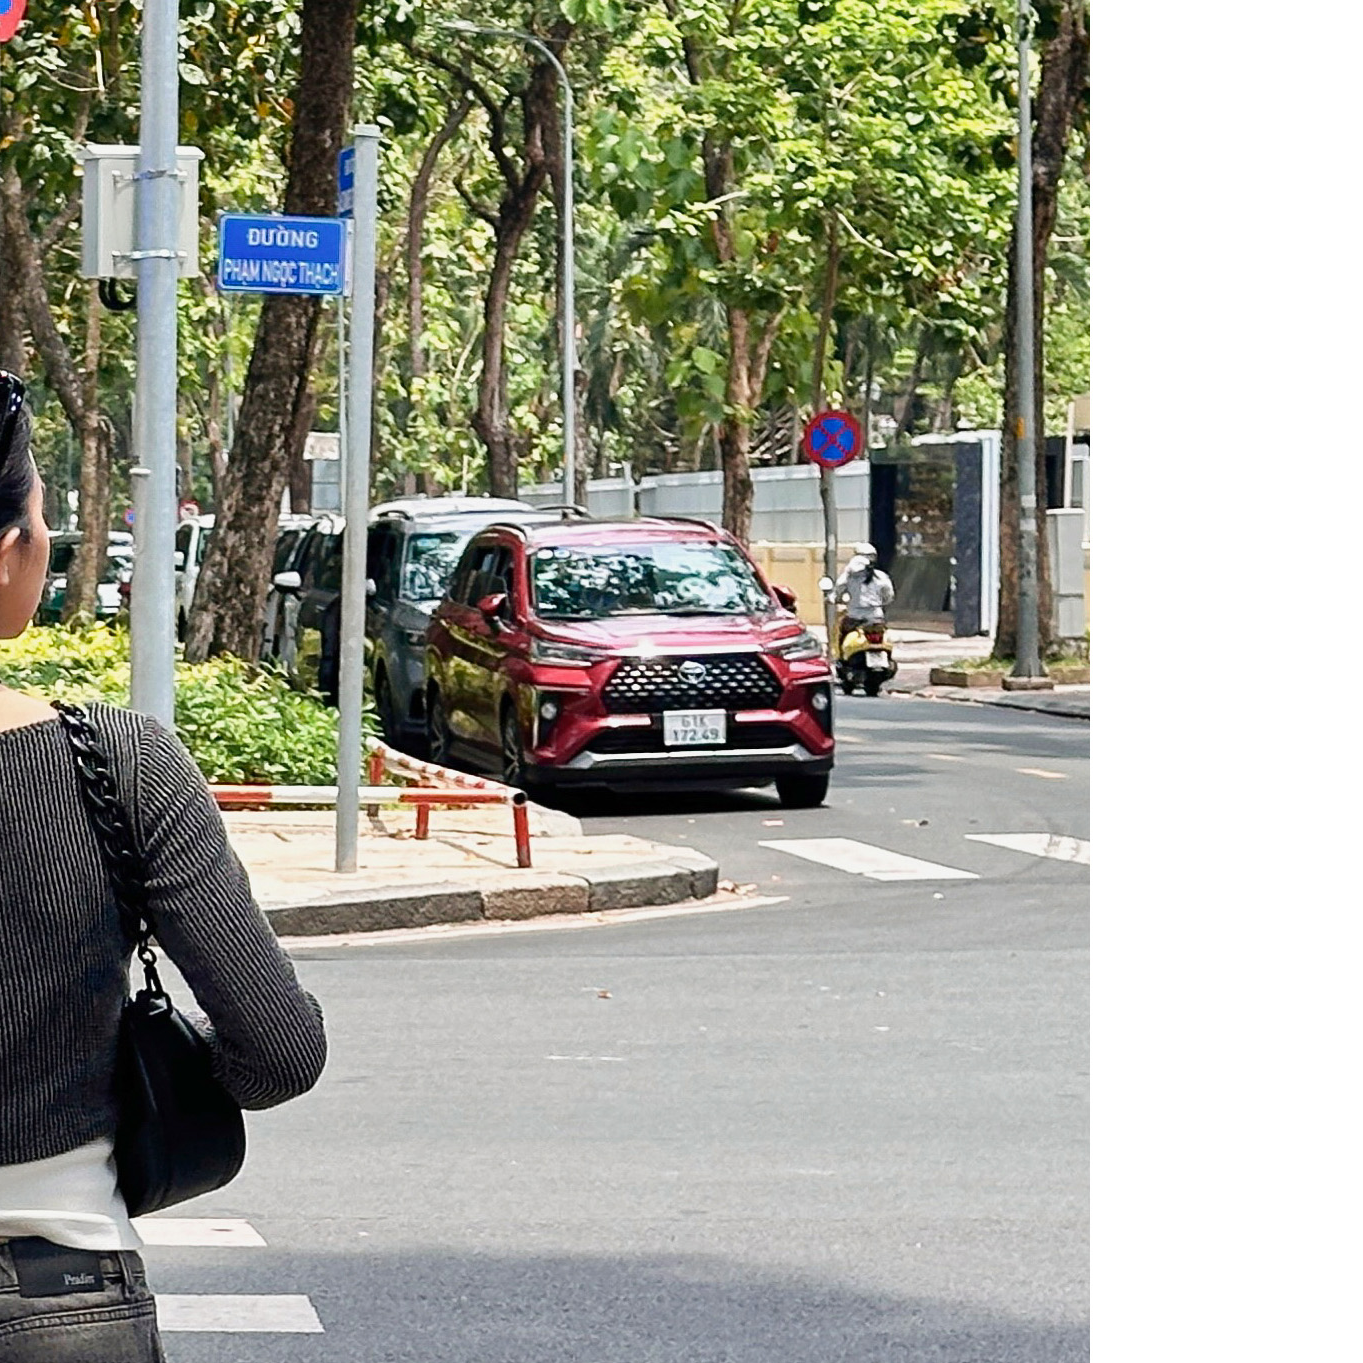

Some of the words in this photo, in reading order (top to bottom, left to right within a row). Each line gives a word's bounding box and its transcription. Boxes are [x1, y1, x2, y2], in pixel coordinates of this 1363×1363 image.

[247, 224, 320, 249] ĐƯỜNG
[224, 258, 261, 286] PHẠM
[262, 260, 298, 287] NGỌC
[299, 262, 338, 289] THẠCH
